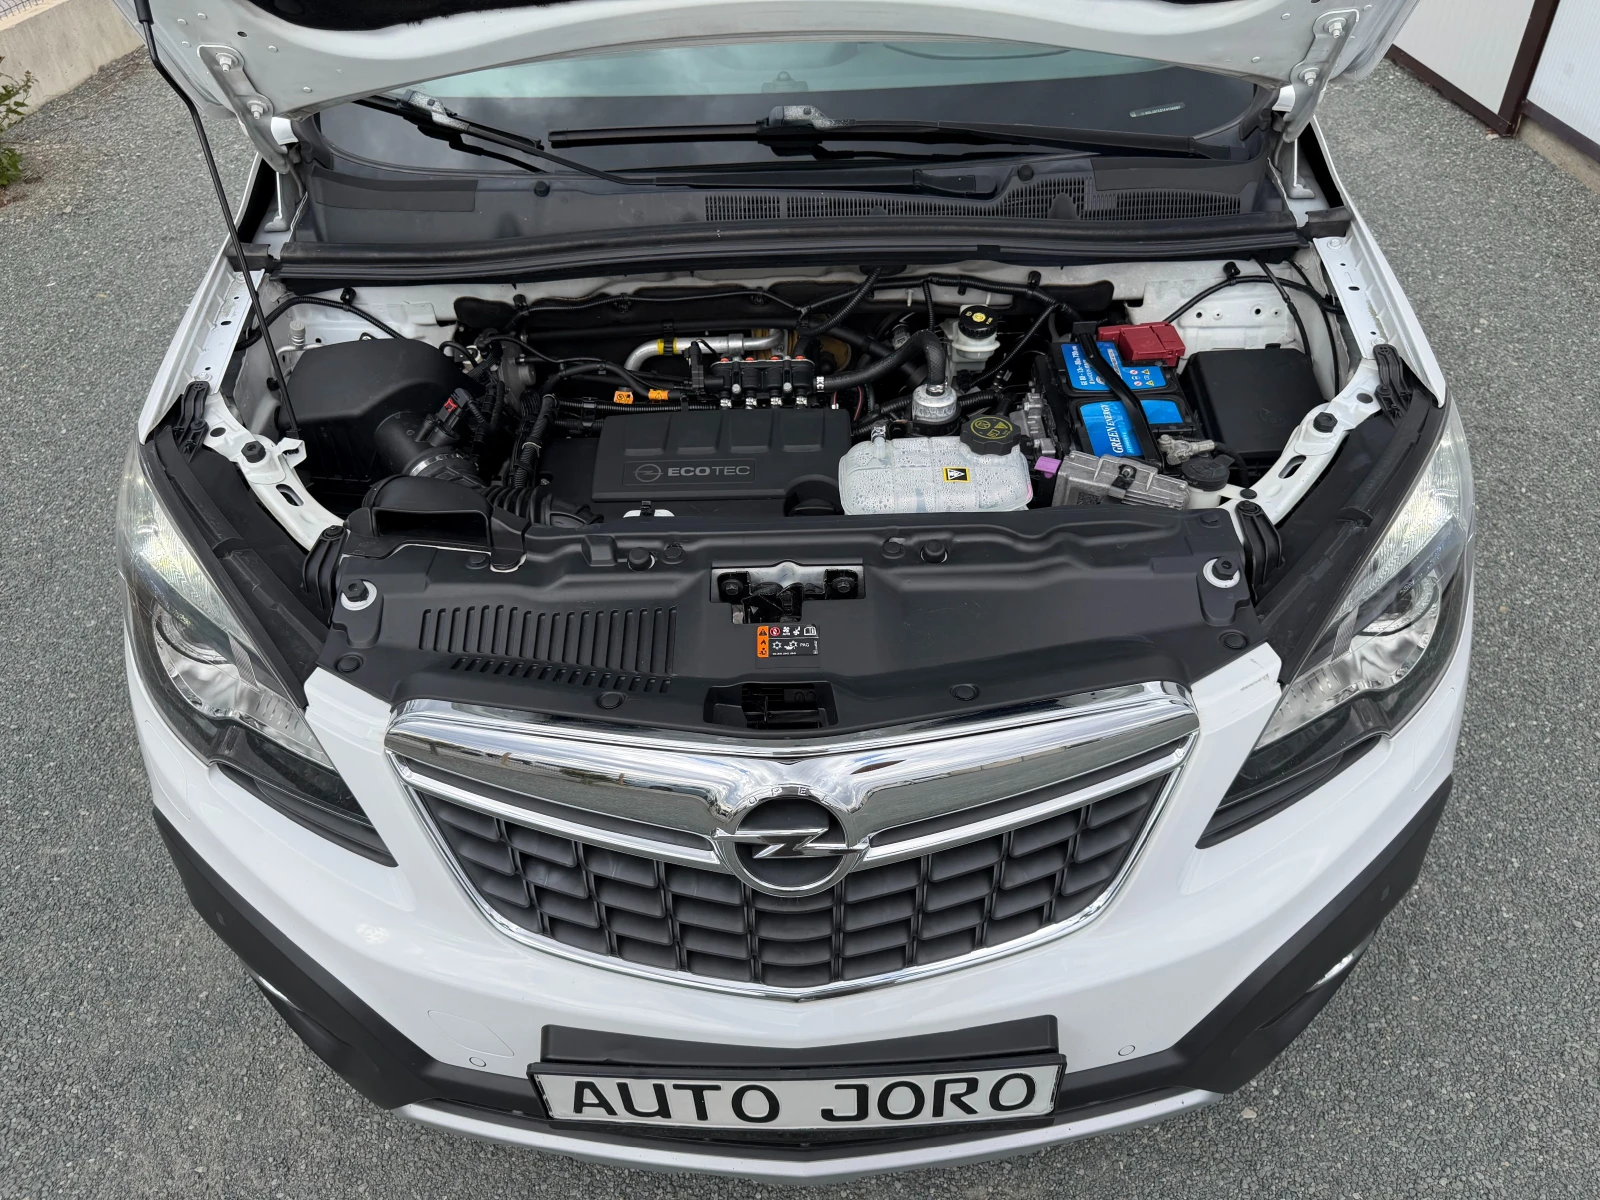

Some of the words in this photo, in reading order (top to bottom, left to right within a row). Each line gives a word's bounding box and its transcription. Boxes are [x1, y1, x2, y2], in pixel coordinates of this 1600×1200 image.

[1100, 403, 1115, 426] ENERGY
[1106, 426, 1124, 454] GREEN
[667, 465, 751, 477] ECOTEC
[573, 1080, 781, 1123] AUTO
[820, 1072, 1037, 1122] JORO
